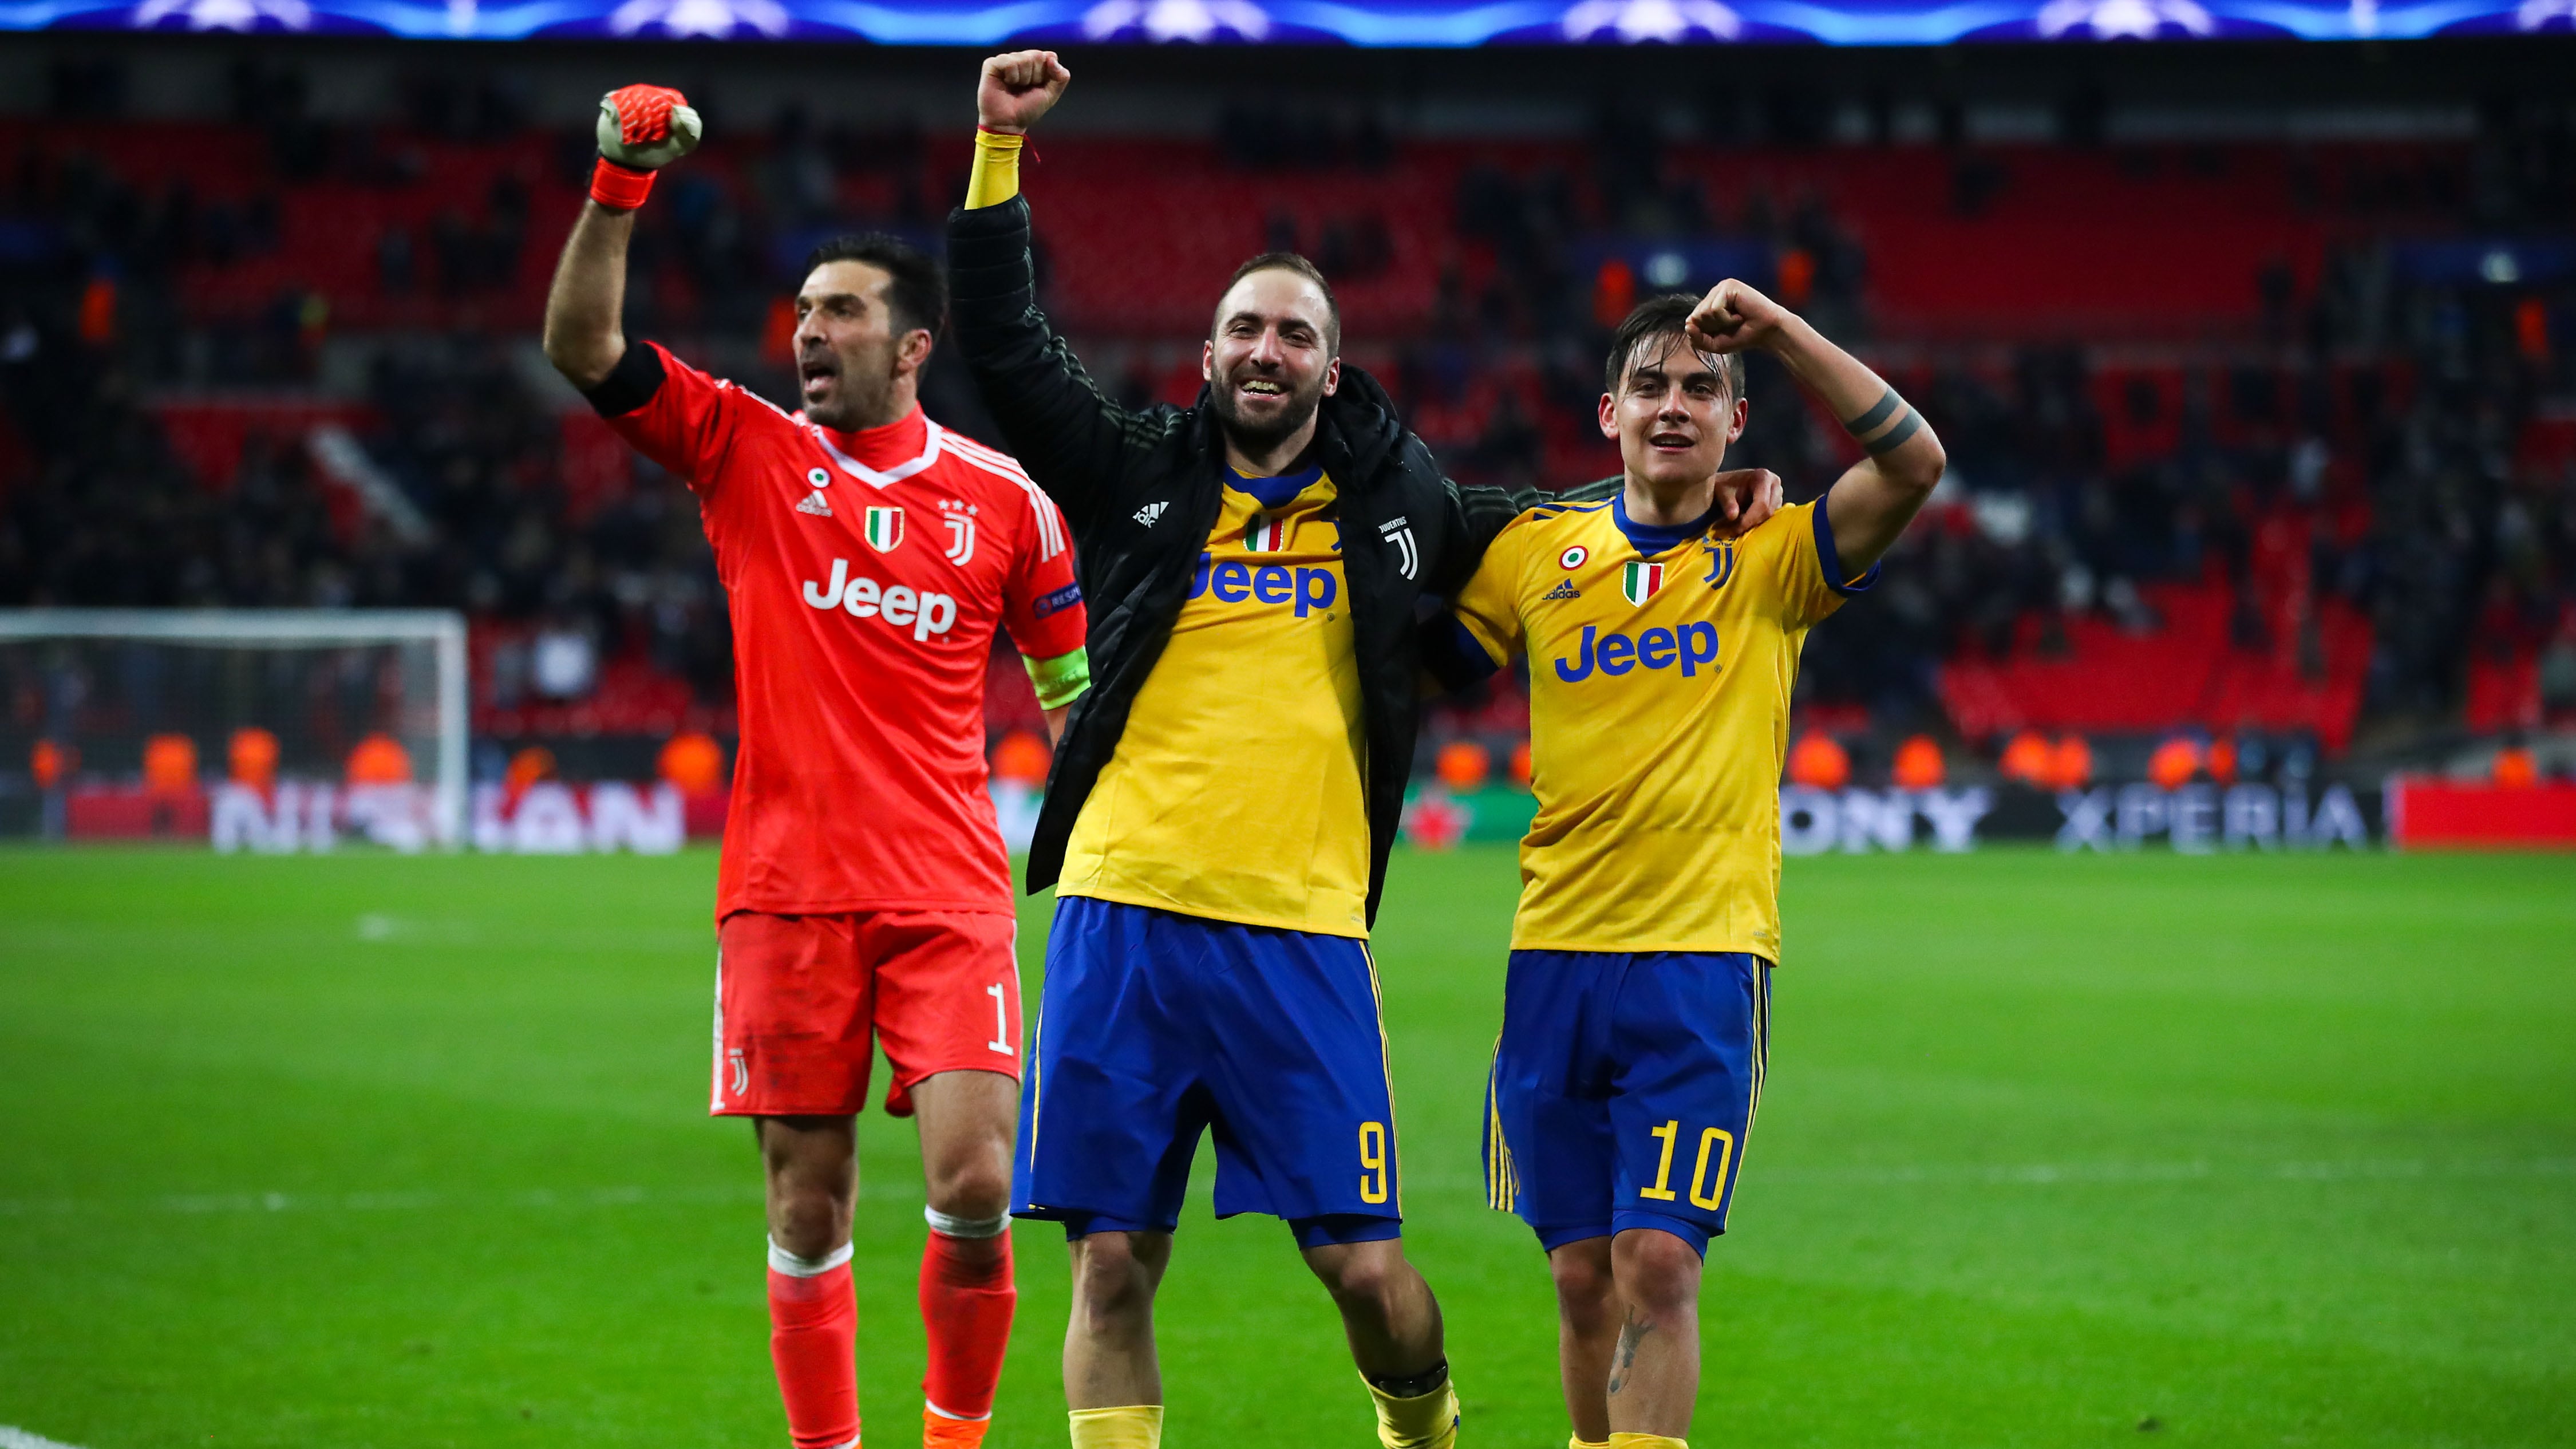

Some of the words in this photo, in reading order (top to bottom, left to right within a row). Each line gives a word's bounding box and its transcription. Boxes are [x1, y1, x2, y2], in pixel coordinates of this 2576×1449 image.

[1378, 516, 1407, 534] JUVENTUS
[803, 558, 957, 642] Jeep
[1555, 621, 1719, 683] Jeep
[1779, 784, 1998, 854] ONY
[986, 982, 1014, 1056] 1
[1358, 1121, 1388, 1204] 9
[1639, 1120, 1733, 1211] 10
